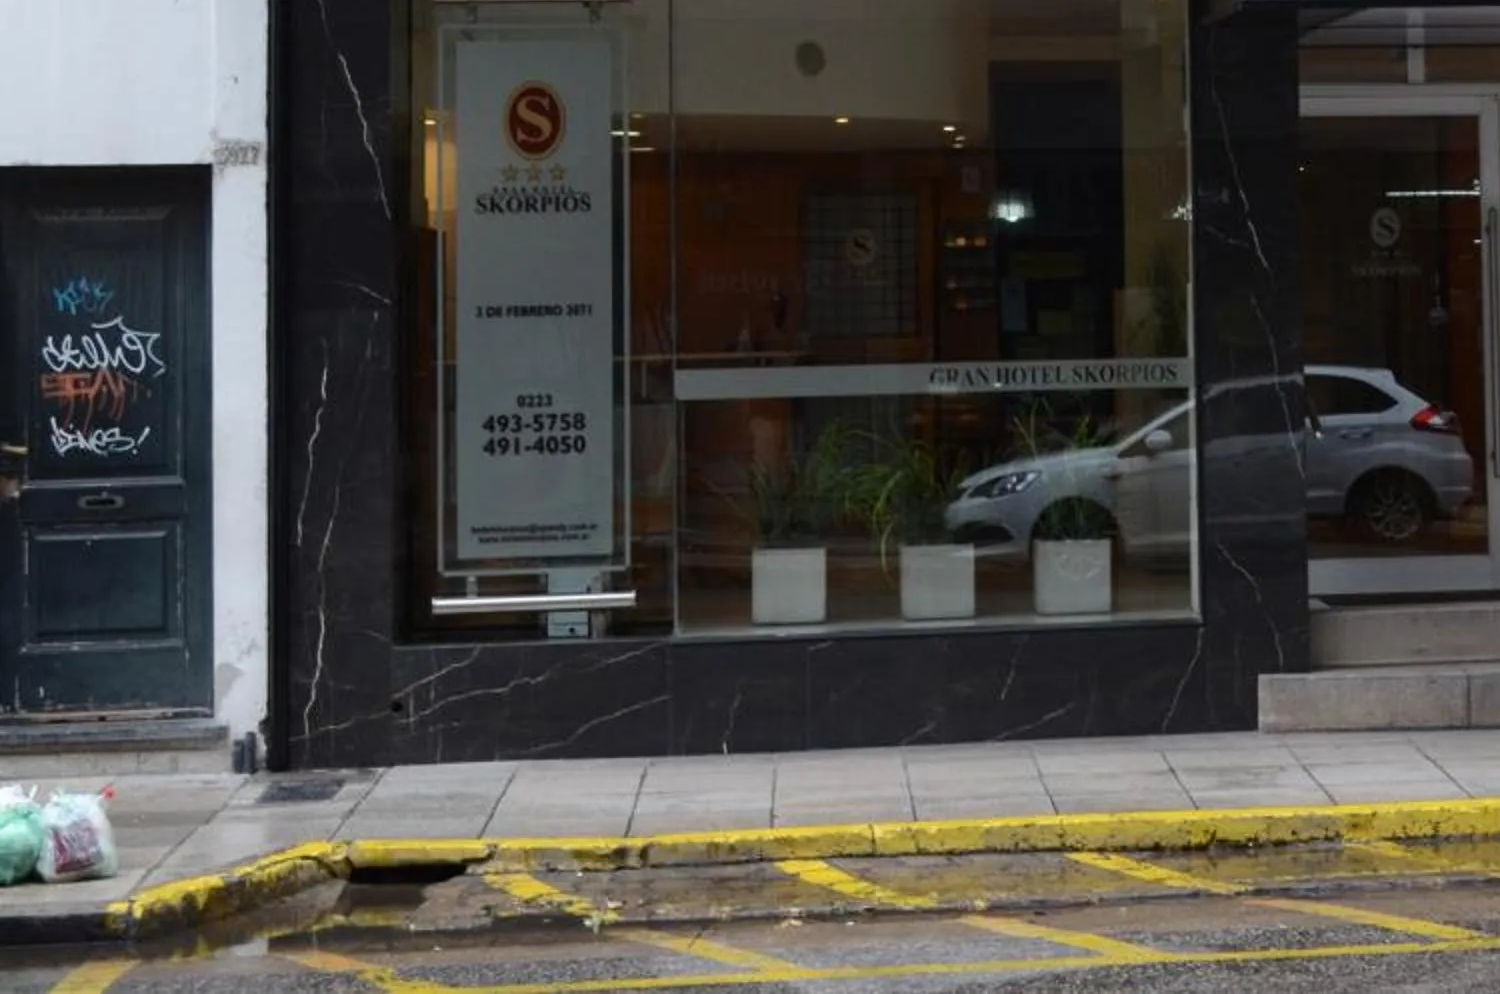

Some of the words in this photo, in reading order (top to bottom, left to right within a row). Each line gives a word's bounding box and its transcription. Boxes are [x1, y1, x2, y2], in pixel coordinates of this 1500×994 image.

[475, 191, 592, 213] SKORPIOS
[486, 306, 503, 318] DE
[506, 304, 563, 317] FEBRERO
[929, 366, 991, 387] GRAN
[996, 364, 1068, 386] HOTEL
[1072, 364, 1179, 384] SKORPIOS
[517, 394, 553, 408] 0223
[482, 413, 586, 433] 493-5758
[482, 435, 586, 455] 491-4050
